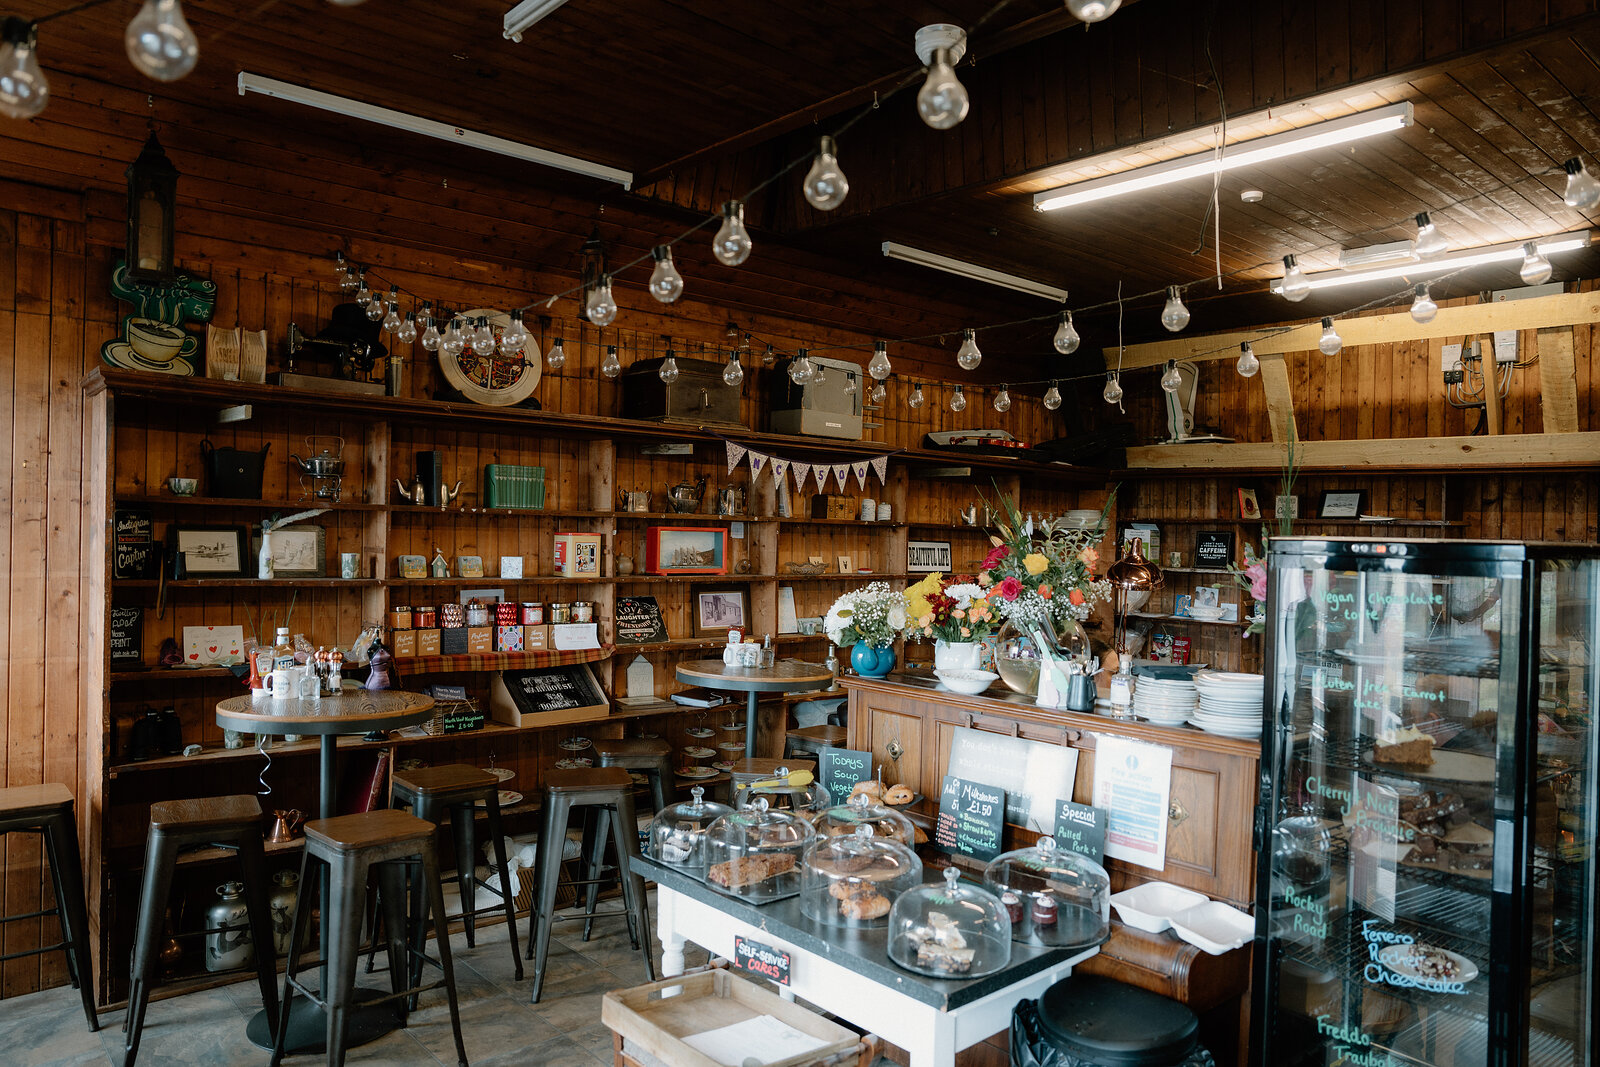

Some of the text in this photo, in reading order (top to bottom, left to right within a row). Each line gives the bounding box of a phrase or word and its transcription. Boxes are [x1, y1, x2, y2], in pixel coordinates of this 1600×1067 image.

[909, 546, 950, 567] BEAUTIFUL LIFE
[1319, 591, 1354, 612] Vegan
[523, 682, 575, 694] WAREHOUSE
[966, 800, 992, 817] £1.50
[1305, 775, 1352, 817] Cherry
[1062, 804, 1096, 824] Special
[1356, 808, 1415, 841] Brownie
[1057, 826, 1082, 841] Pulled
[1072, 840, 1089, 854] Pork
[1284, 885, 1324, 926] Rocky
[1293, 913, 1327, 940] Road
[1361, 919, 1415, 945] Ferrero
[738, 942, 788, 971] SELF-SERVICE
[1367, 942, 1426, 968] Rocher
[1316, 1013, 1370, 1046] Freddo
